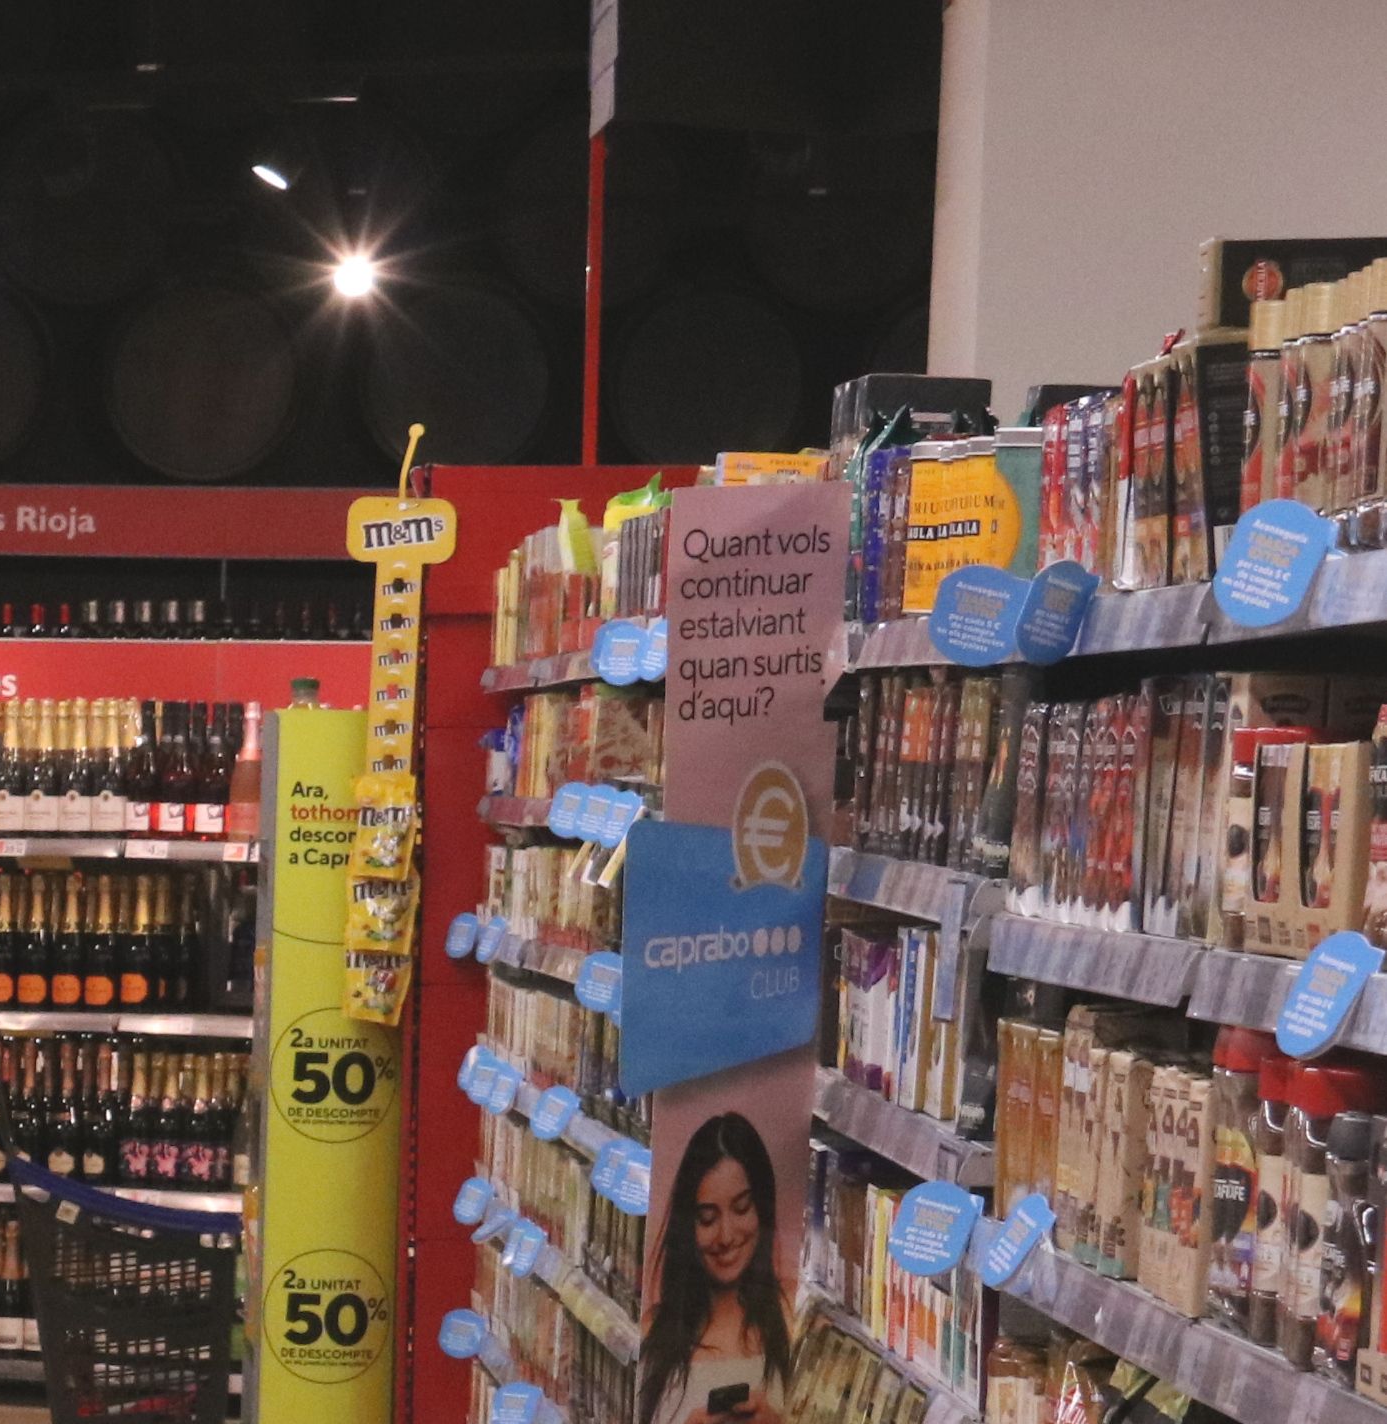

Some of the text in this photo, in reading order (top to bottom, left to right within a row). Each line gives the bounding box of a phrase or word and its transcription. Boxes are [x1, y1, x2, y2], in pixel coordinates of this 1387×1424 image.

[16, 506, 97, 540] Rioja
[684, 525, 831, 563] Quant vols
[680, 568, 813, 599] continuar
[679, 607, 806, 640] estalviant
[679, 645, 823, 688] quan surtis
[678, 686, 775, 725] d'aquí?
[291, 780, 329, 800] Ara,
[289, 852, 298, 866] a
[645, 926, 749, 973] caprabo
[751, 966, 800, 999] CLUB
[289, 1028, 370, 1050] 2a UNITAT
[291, 1050, 394, 1105] 50%
[287, 1107, 381, 1120] DE DESCOMPTE
[283, 1269, 362, 1291] 2a UNITAT
[284, 1292, 388, 1347] 50%
[280, 1347, 374, 1360] DE DESCOMPTE
